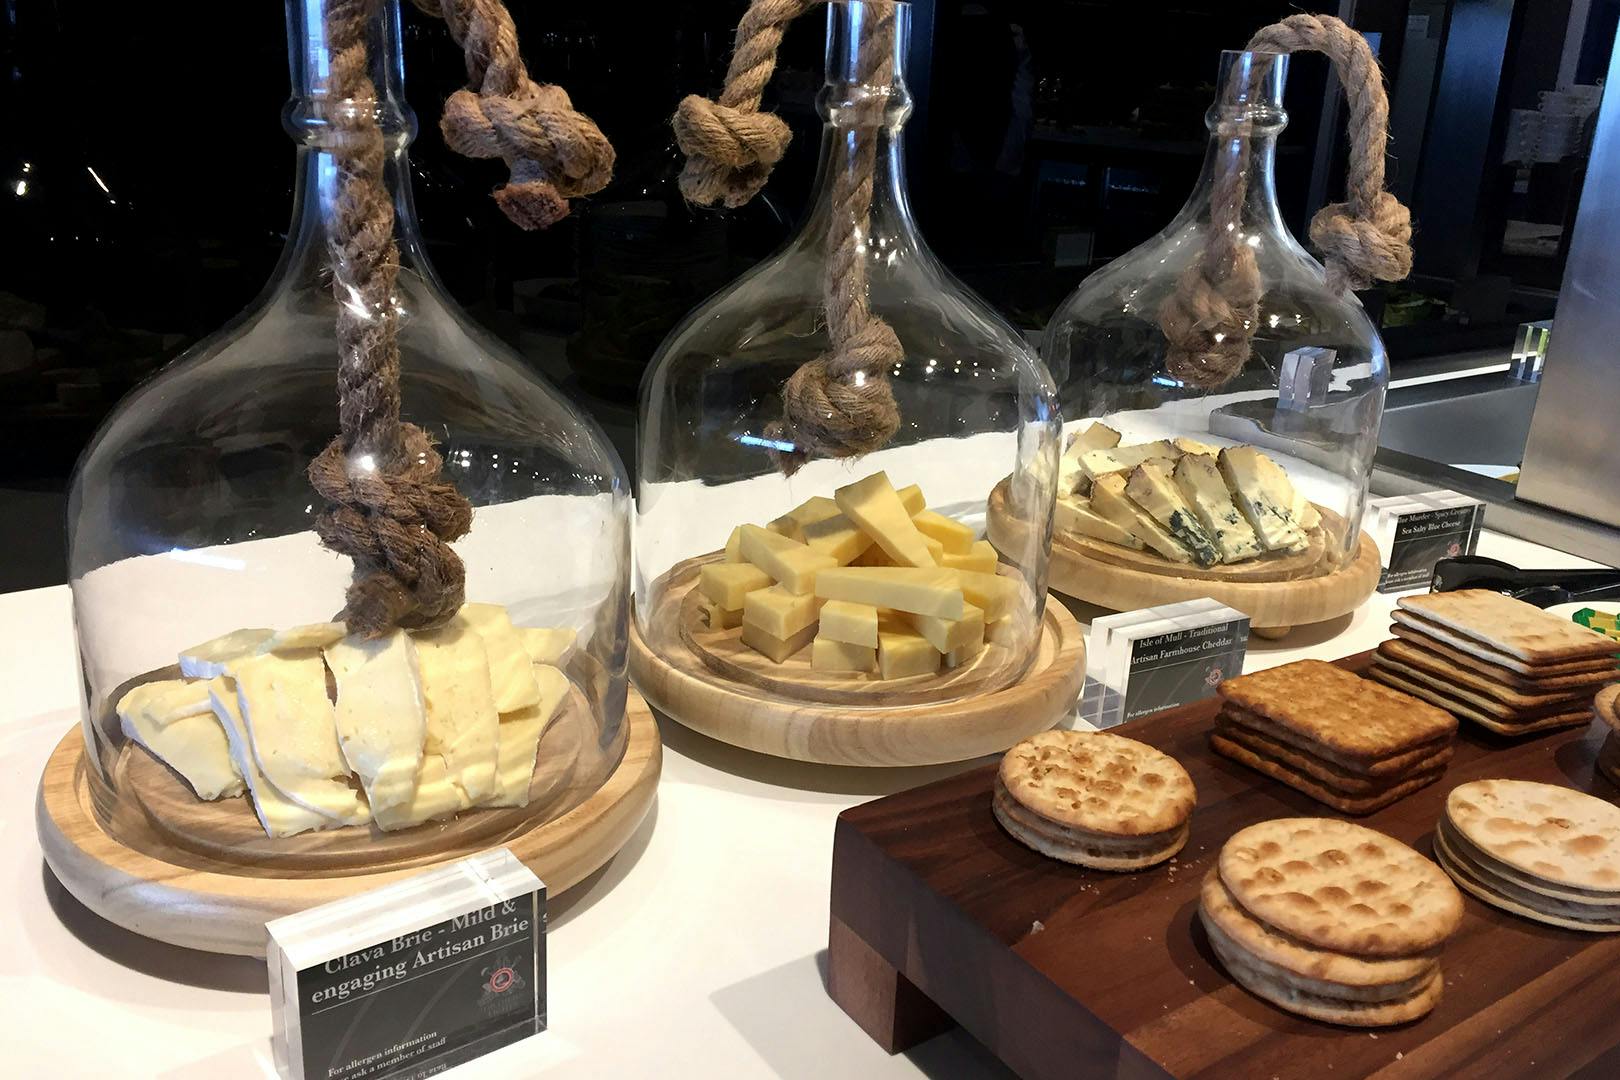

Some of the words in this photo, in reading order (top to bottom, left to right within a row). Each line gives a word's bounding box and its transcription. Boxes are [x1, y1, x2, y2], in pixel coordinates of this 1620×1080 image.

[1401, 527, 1412, 535] Sea
[1428, 523, 1441, 531] Blue
[1441, 520, 1461, 530] Cheese
[1131, 652, 1158, 665] Artisan
[1160, 645, 1201, 659] Farmhouse
[1202, 637, 1232, 650] Cheddar
[1139, 639, 1154, 649] Isle
[1155, 636, 1164, 646] of
[1165, 632, 1182, 643] Mull
[1189, 623, 1229, 638] Traditional
[324, 944, 385, 975] Clava
[390, 929, 433, 954] Brie
[451, 907, 496, 934] Mild
[501, 899, 517, 915] &
[312, 961, 407, 1004] engaging
[412, 933, 485, 969] Artisan
[490, 918, 529, 942] Brie
[328, 1065, 345, 1078] For
[345, 1052, 383, 1071] allergen
[384, 1031, 437, 1056] information
[351, 1068, 369, 1080] ask
[376, 1052, 416, 1070] member
[416, 1046, 426, 1055] of
[427, 1036, 448, 1051] staff
